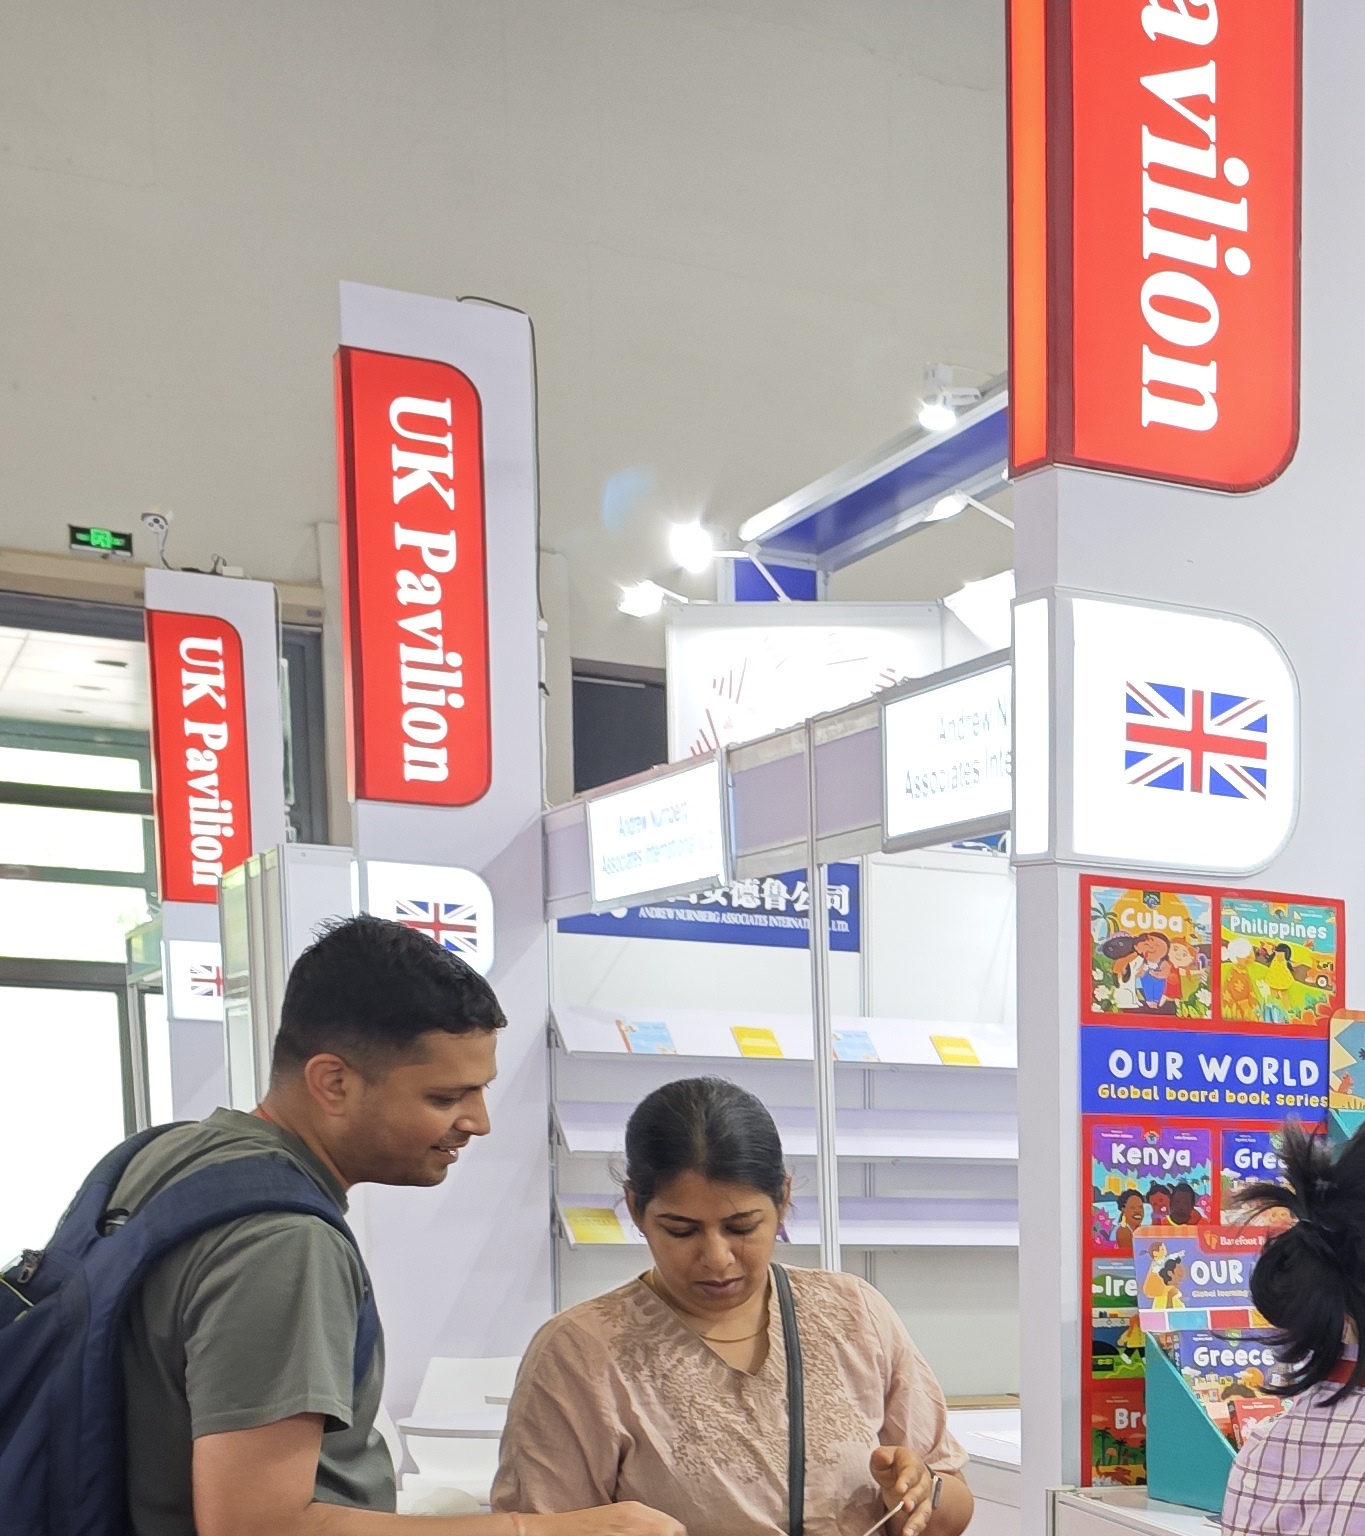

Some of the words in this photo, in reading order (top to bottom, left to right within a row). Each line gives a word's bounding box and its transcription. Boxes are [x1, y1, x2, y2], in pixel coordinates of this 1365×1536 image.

[389, 397, 454, 510] UK
[394, 521, 465, 782] Pavilion
[179, 636, 226, 710] UK
[184, 719, 235, 887] Pavilion
[1120, 907, 1183, 933] Cuba
[1230, 915, 1327, 941] Philippines
[1108, 1048, 1184, 1081] OUR
[1197, 1053, 1320, 1087] WORLD
[1097, 1083, 1160, 1102] Global
[1165, 1086, 1219, 1104] board
[1225, 1088, 1271, 1106] book
[1275, 1091, 1329, 1109] series
[1111, 1142, 1191, 1170] Kenya
[1191, 1260, 1244, 1285] OUR
[1194, 1346, 1275, 1367] Greece
